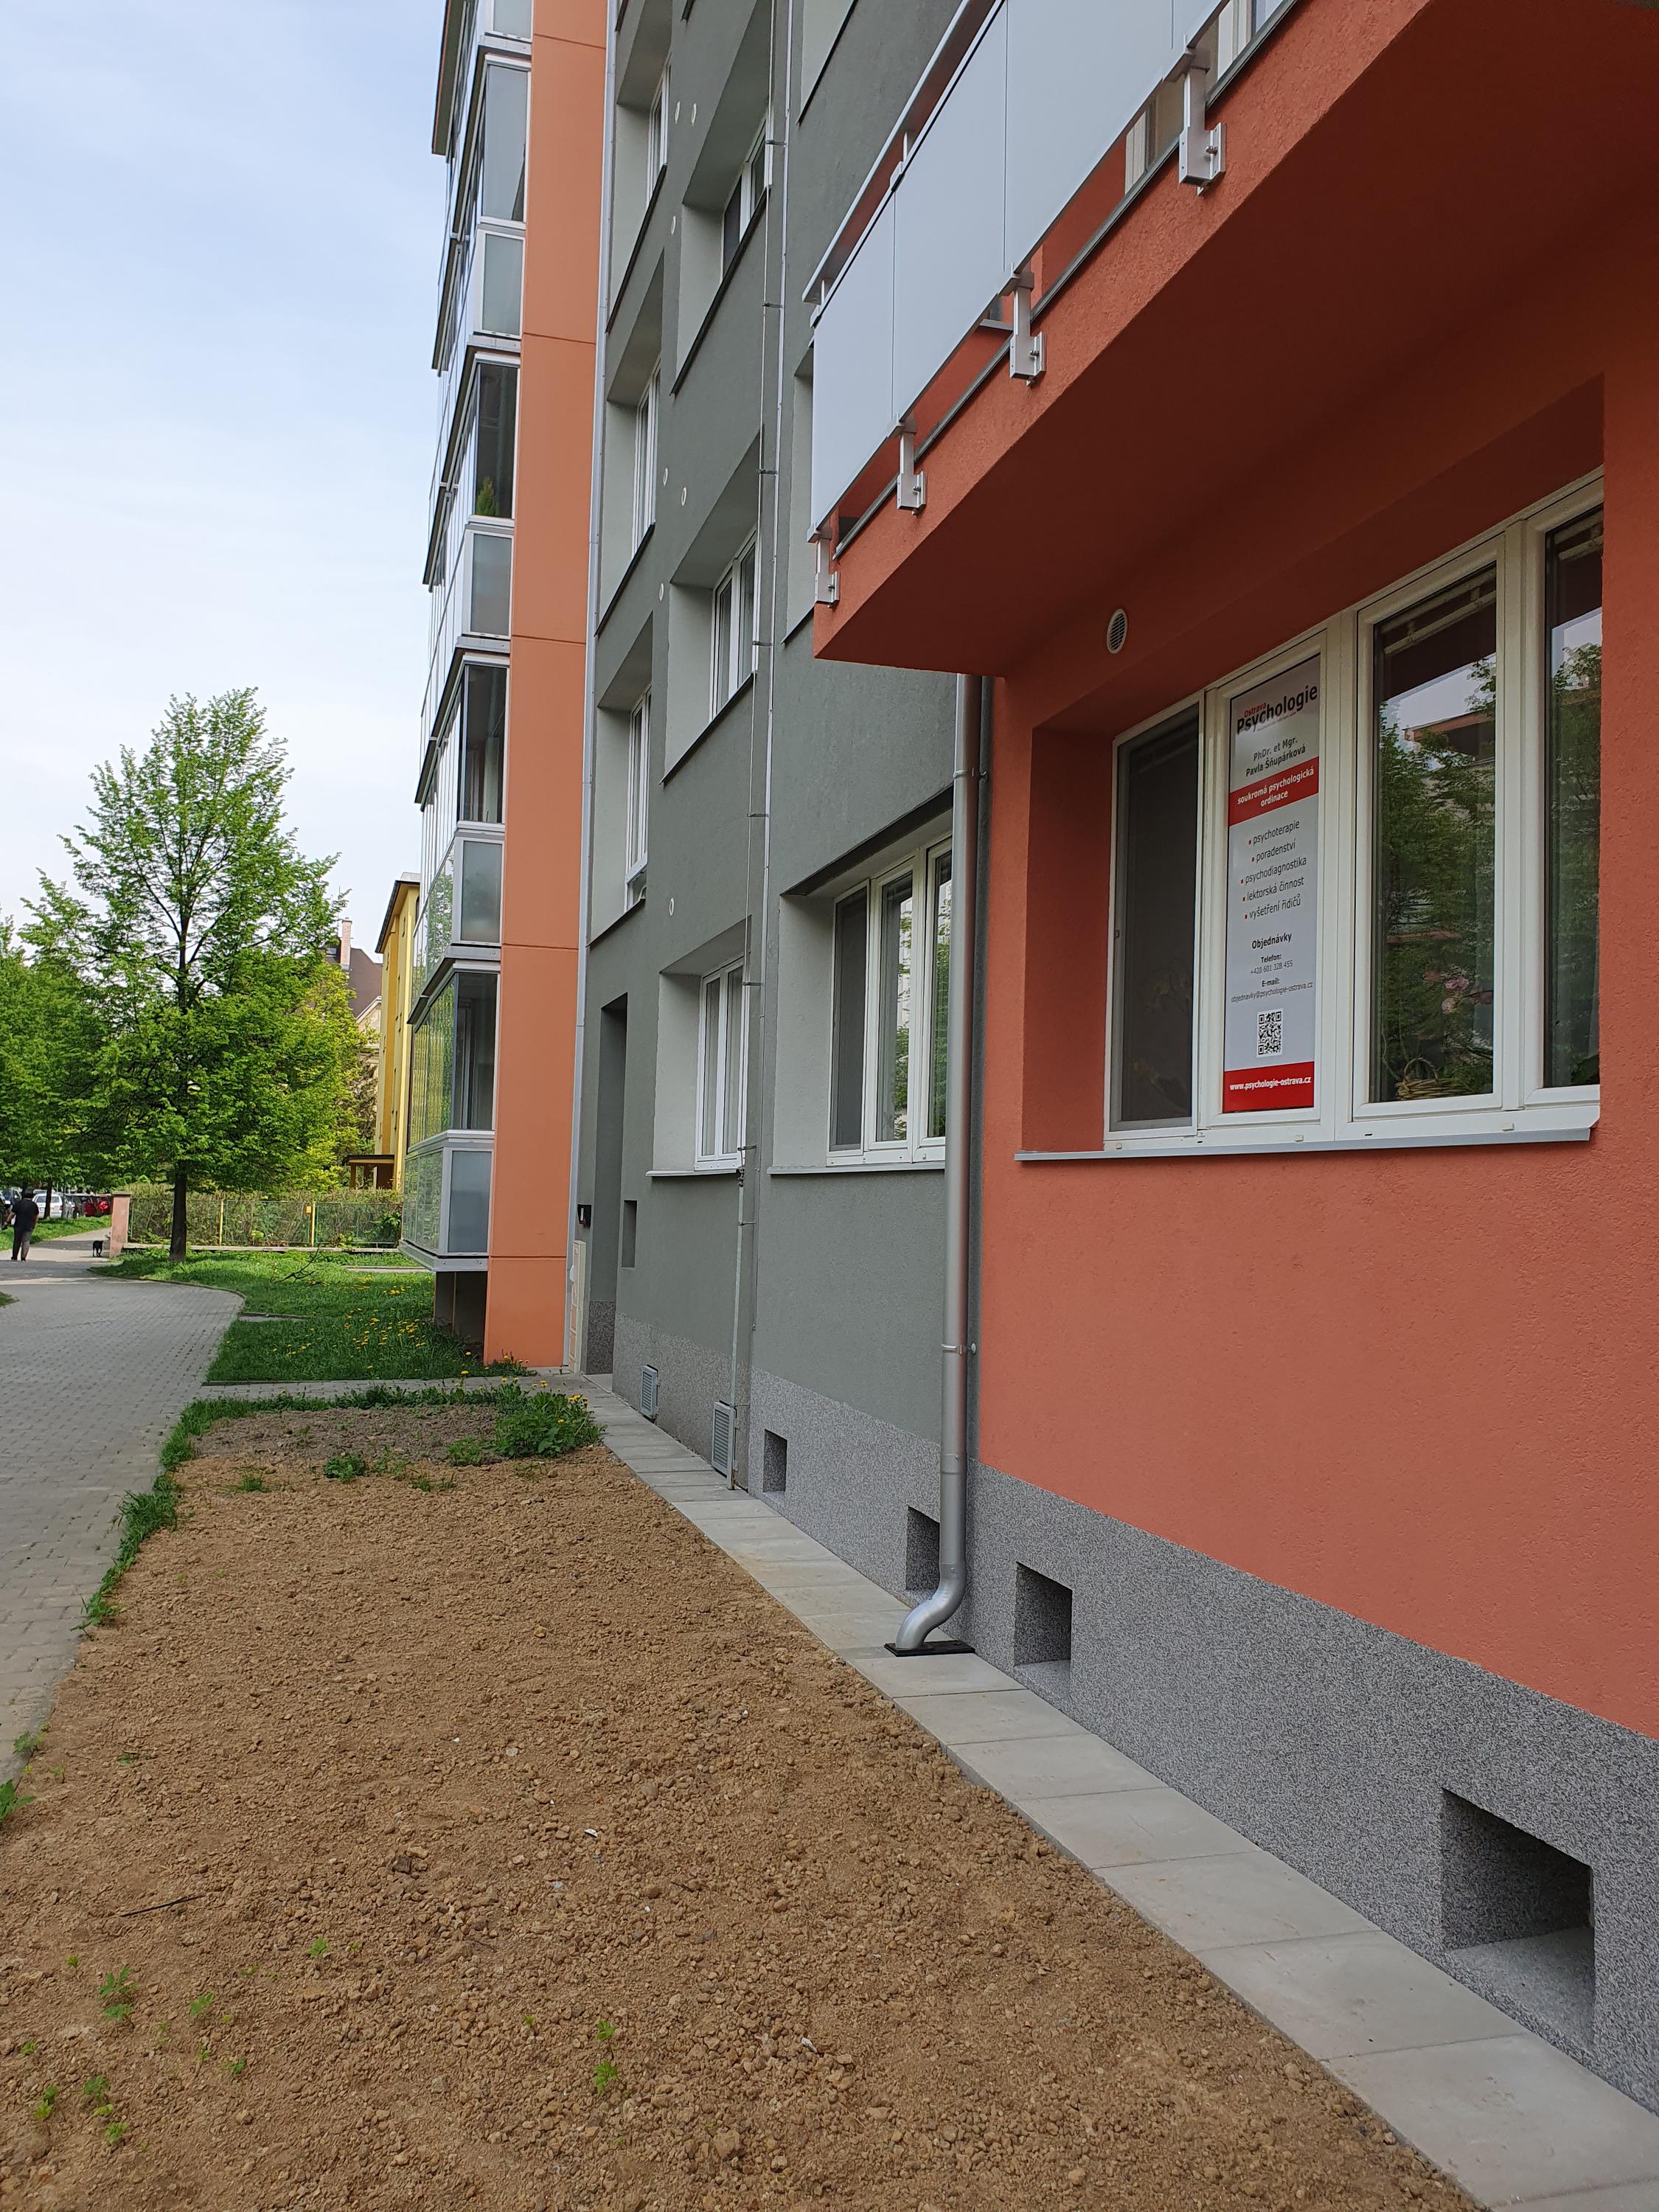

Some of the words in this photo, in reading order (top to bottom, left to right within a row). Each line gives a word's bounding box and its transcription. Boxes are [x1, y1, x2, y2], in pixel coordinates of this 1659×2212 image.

[1237, 685, 1318, 735] Psychologie
[1244, 703, 1267, 717] Ostrava
[1245, 764, 1263, 777] Pavla
[1265, 744, 1306, 769] Šňupárková
[1253, 748, 1272, 761] PhDr.
[1273, 743, 1281, 752] et
[1282, 737, 1298, 749] Mgr.
[1237, 785, 1267, 804] soukromá
[1268, 766, 1314, 793] psychologická
[1261, 790, 1289, 807] ordinace
[1253, 820, 1300, 846] psychoterapie
[1256, 838, 1296, 863] poradenství
[1245, 857, 1307, 885] psychodiagnostika
[1247, 883, 1277, 901] lektorská
[1279, 877, 1304, 892] činnost
[1249, 900, 1280, 920] vyšetření
[1281, 893, 1301, 910] řidičů
[1251, 932, 1292, 950] Objednávky
[1261, 954, 1281, 963] Telefon:
[1262, 977, 1279, 987] E-mail:
[1229, 1077, 1312, 1091] www.psychologie-ostrava.cz
